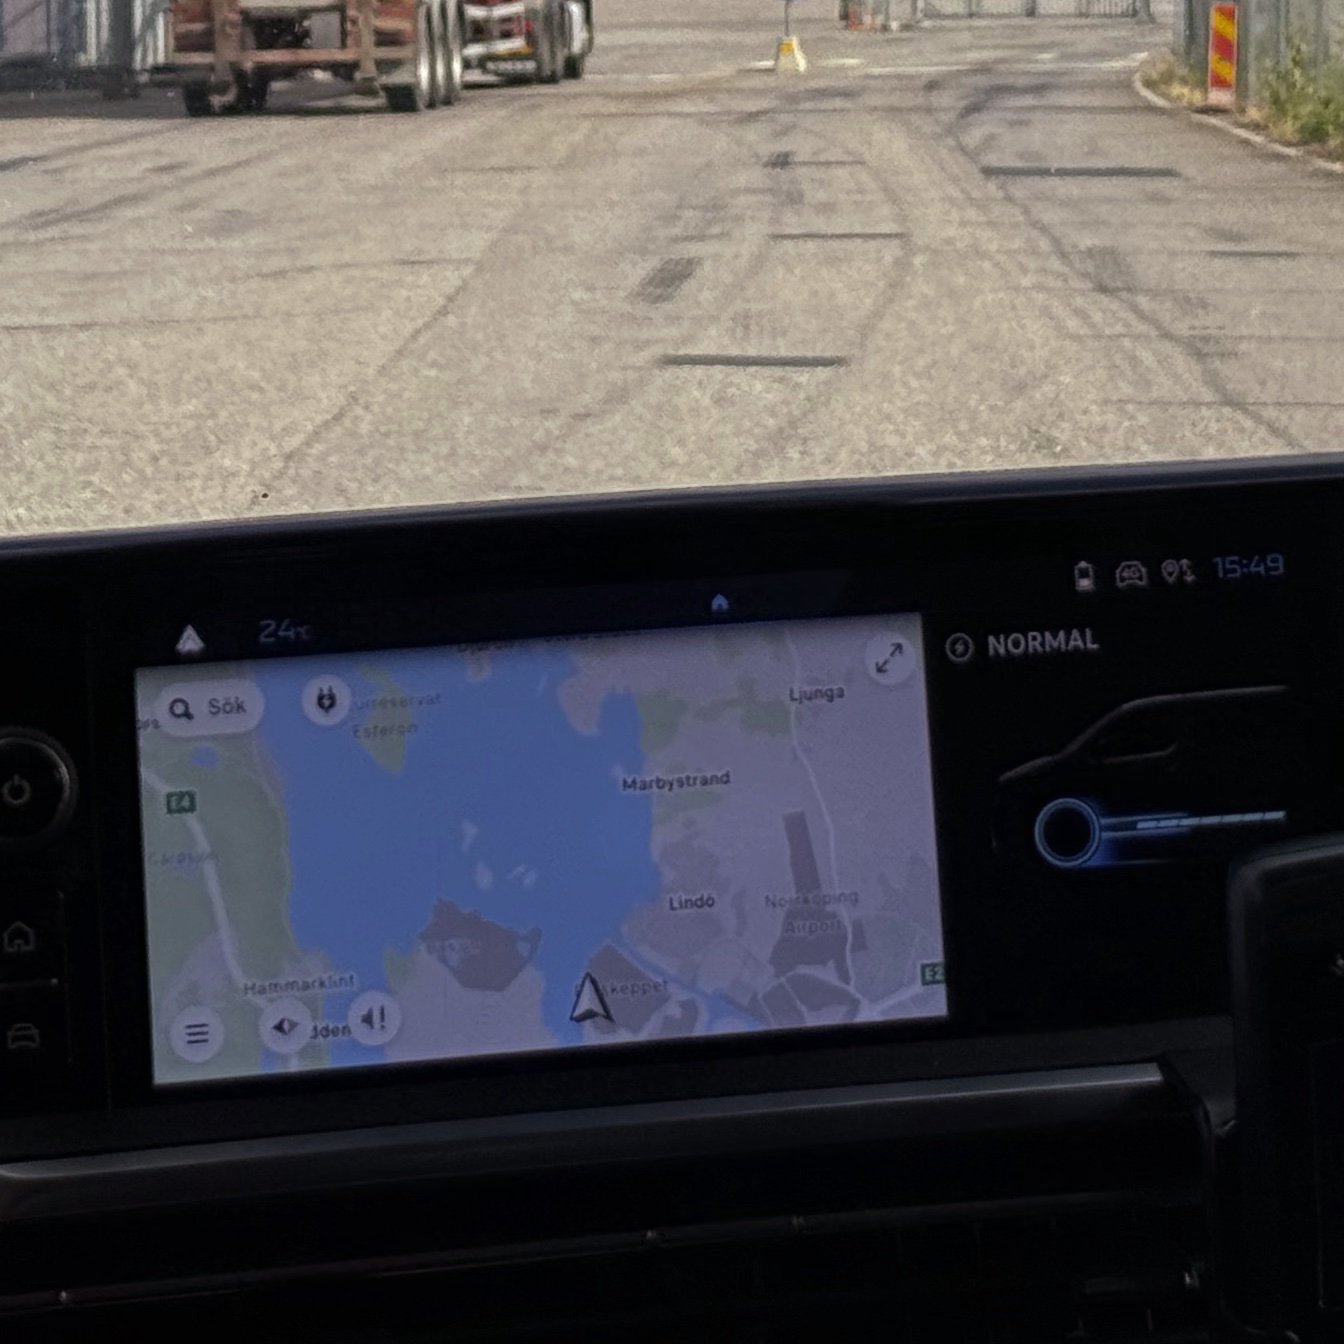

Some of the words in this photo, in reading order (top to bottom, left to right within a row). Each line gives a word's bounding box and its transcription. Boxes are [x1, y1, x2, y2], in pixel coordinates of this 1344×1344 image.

[1211, 552, 1286, 580] 15:49
[987, 627, 1101, 658] NORMAL
[207, 695, 247, 718] Sök
[788, 685, 846, 705] Ljunga
[621, 770, 732, 793] Marbystrand
[668, 893, 716, 912] Lindö
[784, 918, 843, 937] Airport
[243, 973, 355, 996] Hammarklint
